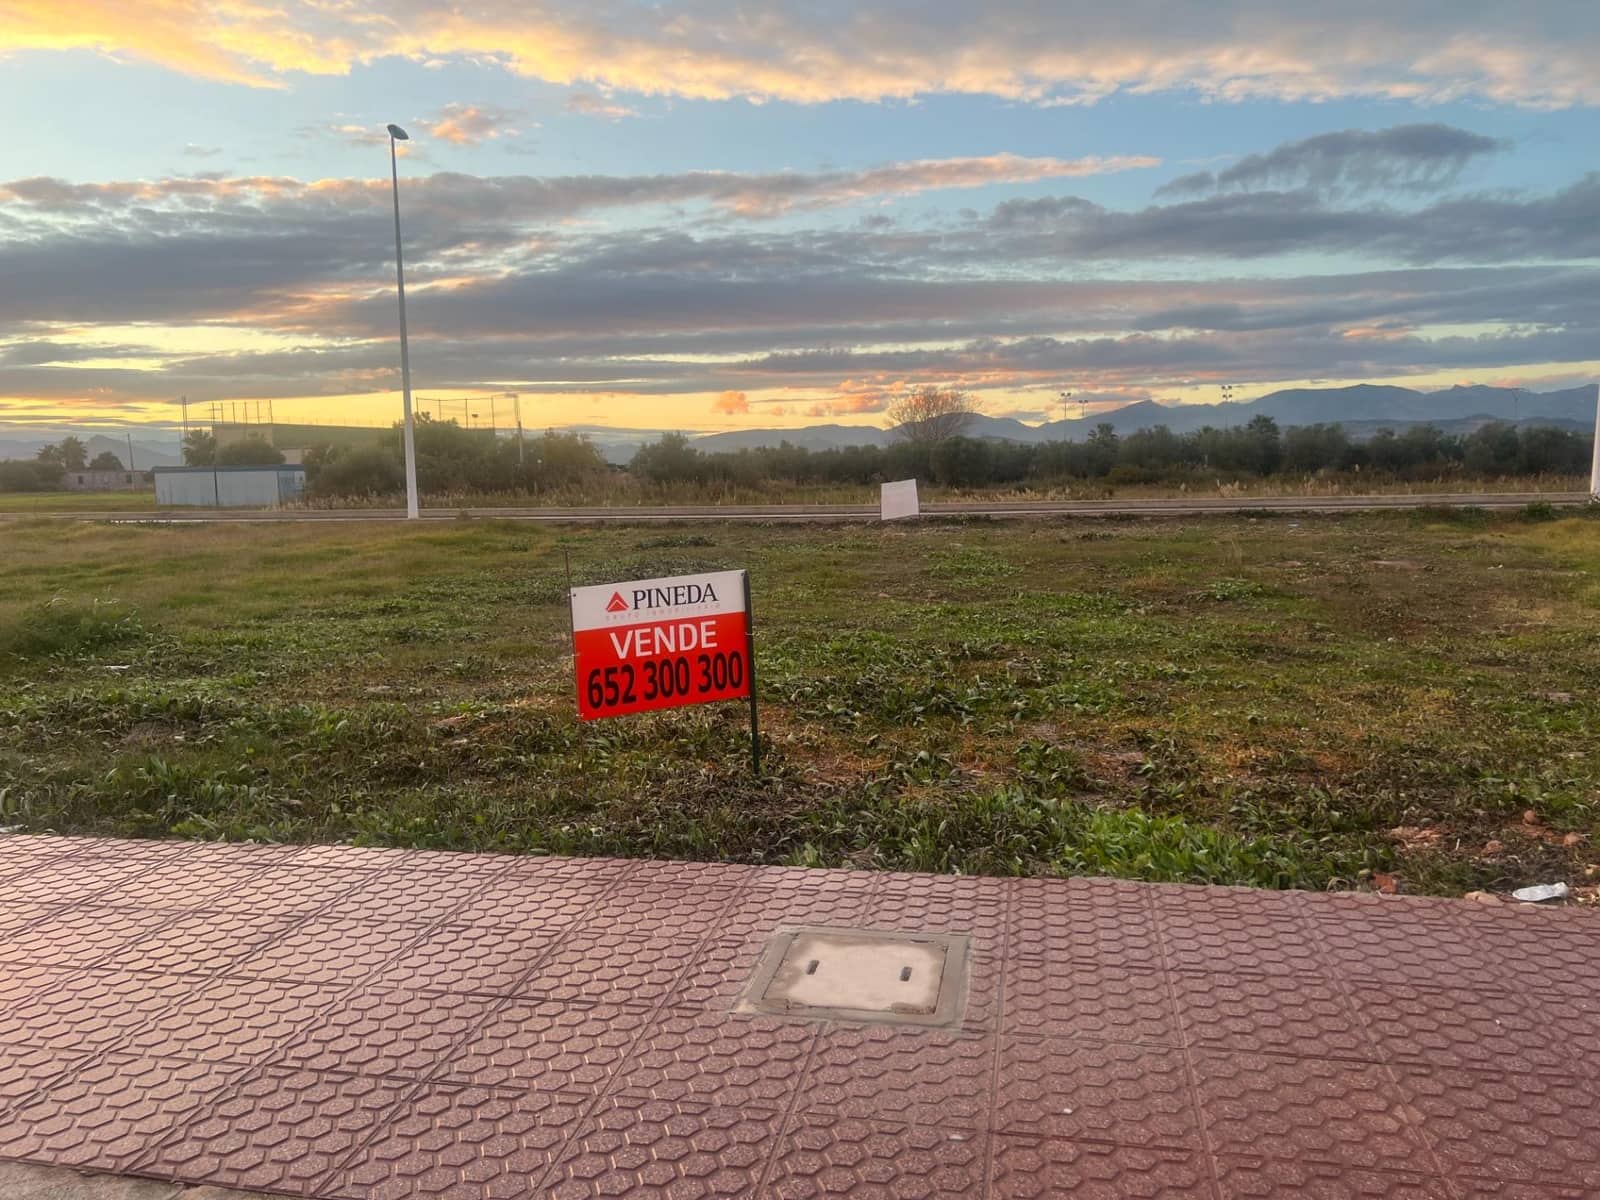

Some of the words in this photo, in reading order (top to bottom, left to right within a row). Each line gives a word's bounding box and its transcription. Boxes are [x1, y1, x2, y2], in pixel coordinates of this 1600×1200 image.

[632, 583, 720, 610] PINEDA
[609, 620, 718, 660] VENDE
[587, 663, 637, 709] 652
[643, 656, 690, 701] 300
[697, 650, 743, 693] 300
